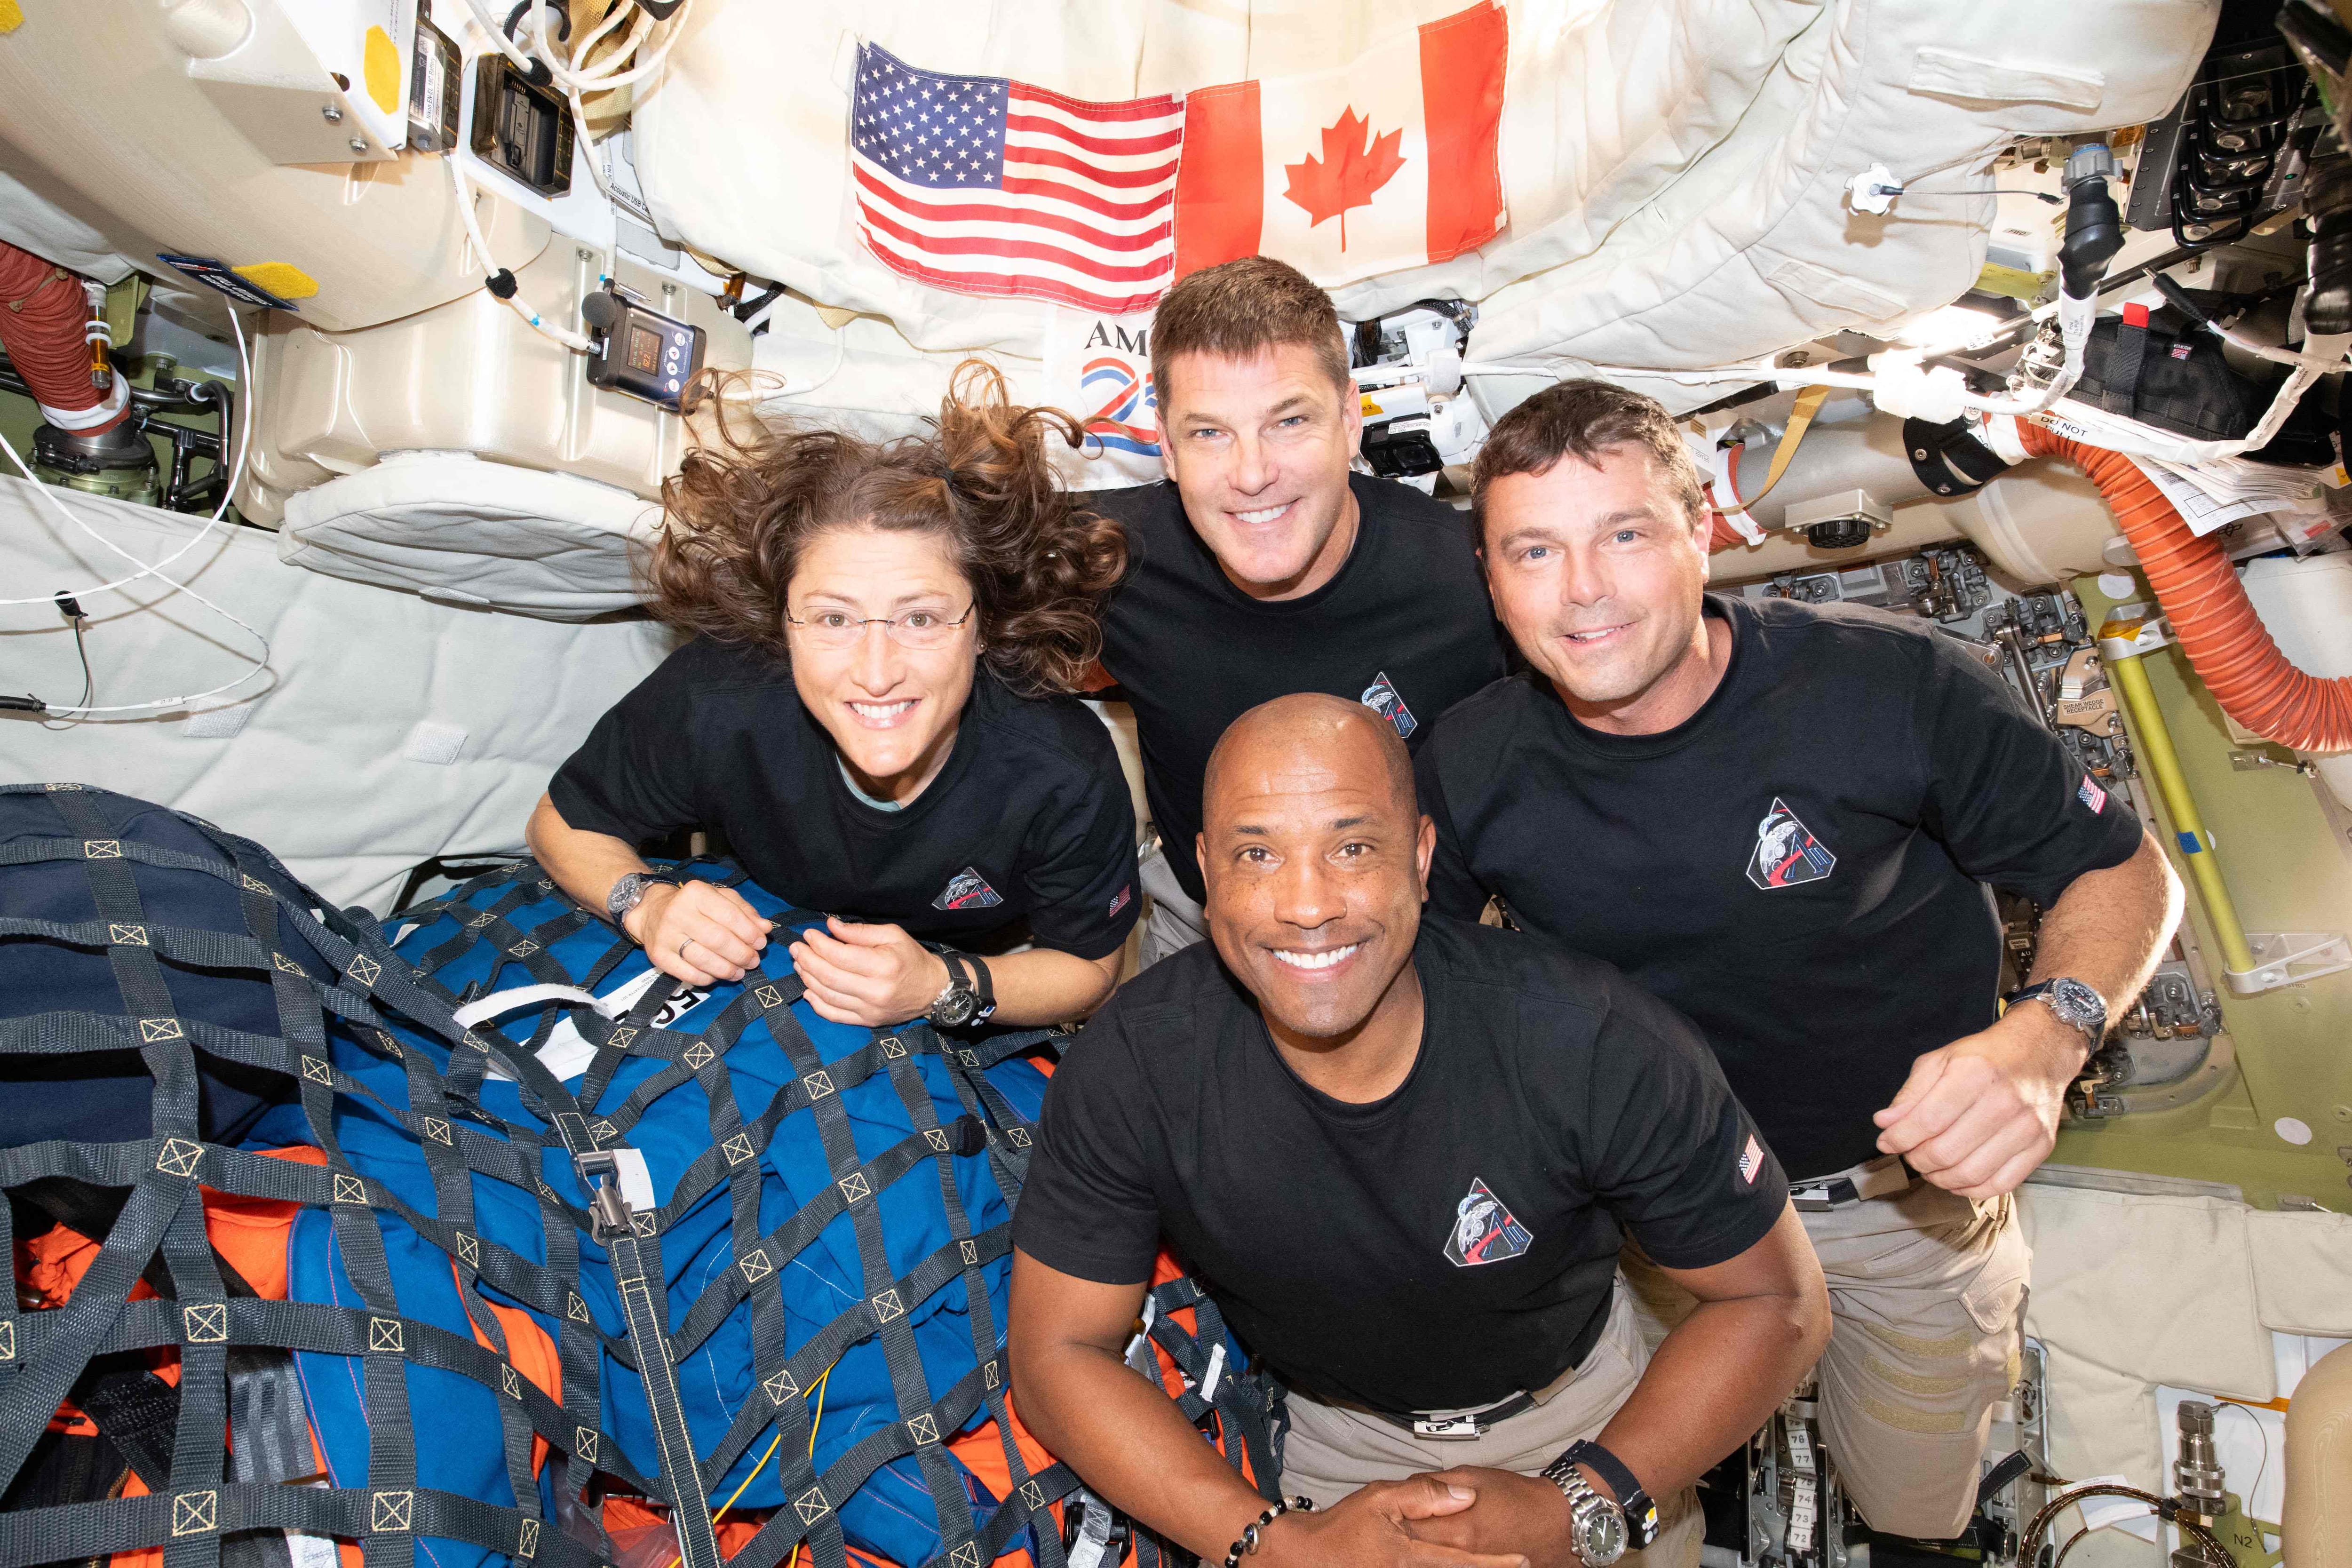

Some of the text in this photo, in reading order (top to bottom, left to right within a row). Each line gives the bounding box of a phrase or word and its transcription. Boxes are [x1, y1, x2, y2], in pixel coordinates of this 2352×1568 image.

[610, 183, 630, 200] Acoustic
[631, 196, 641, 207] USB
[1084, 320, 1148, 357] AM
[2061, 423, 2088, 437] NOT
[2067, 704, 2103, 714] RECEPTACLE
[1794, 1385, 1805, 1396] 81
[1789, 1403, 1796, 1412] 8
[1791, 1435, 1804, 1444] 78
[1796, 1455, 1809, 1464] 77
[1798, 1494, 1811, 1503] 74
[1796, 1514, 1809, 1523] 73
[1794, 1534, 1807, 1543] 72
[2234, 1534, 2252, 1548] N2
